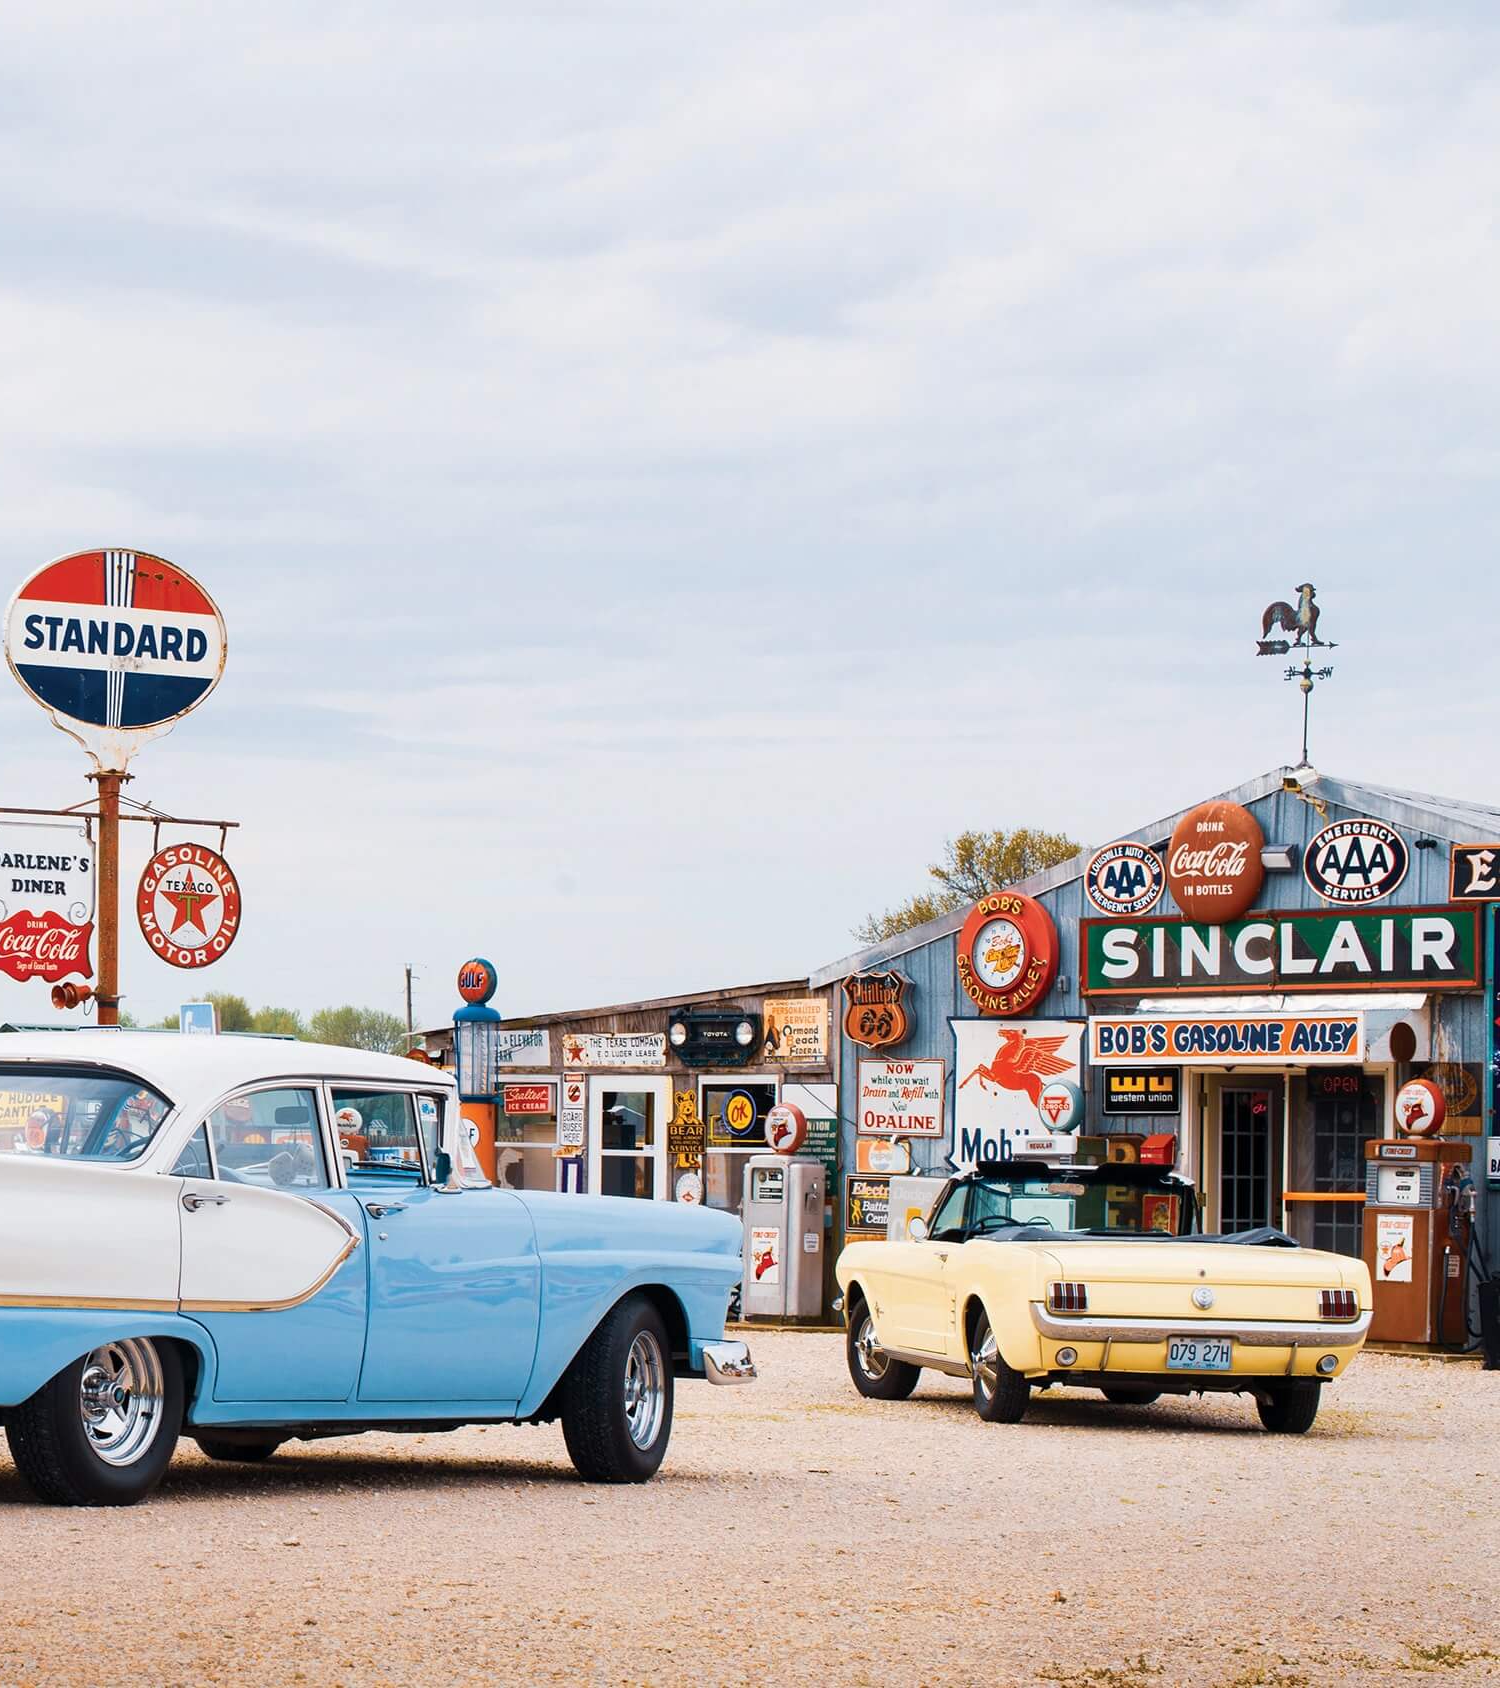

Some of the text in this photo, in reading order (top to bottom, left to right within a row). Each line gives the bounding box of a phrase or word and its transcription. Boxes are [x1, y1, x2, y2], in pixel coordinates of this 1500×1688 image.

[24, 614, 207, 663] STANDARD
[1196, 822, 1225, 833] DRINK
[1316, 823, 1395, 848] EMERGENCY
[1090, 846, 1160, 876] LOUISVILLE AUTO CLUB
[1170, 841, 1250, 878] Coca-Cola
[1320, 837, 1389, 886] AAA
[144, 848, 235, 896] GASOLINE
[1103, 861, 1147, 898] AAA
[12, 879, 67, 896] DINER
[166, 880, 213, 893] TEXACO
[1184, 884, 1233, 896] IN BOTTLES
[1324, 884, 1380, 900] SERVICE
[1090, 883, 1159, 913] EMERGENCY SERVICE
[978, 897, 1023, 915] BOB'S
[142, 912, 237, 965] MOTOR OIL
[1101, 917, 1455, 978] SINCLAIR
[16, 961, 57, 972] Sign of Good Taste
[460, 972, 484, 989] GULF
[957, 954, 1047, 1010] GASOLINE ALLEY
[772, 1006, 821, 1014] PERSONALIZED
[784, 1015, 816, 1024] SERVICE
[861, 1008, 893, 1038] 66
[783, 1025, 819, 1036] Ormond
[1099, 1022, 1357, 1054] BOB'S GASOLINE ALLEY
[509, 1034, 543, 1048] ELEVATOR
[590, 1037, 664, 1048] THE TEXAS COMPANY
[786, 1035, 819, 1046] Beach
[790, 1045, 823, 1056] FEDERAL
[886, 1064, 914, 1074] NOW
[871, 1075, 929, 1087] while you wait
[1324, 1077, 1359, 1092] OPEN
[9, 1092, 59, 1104] HUDDLE
[509, 1086, 548, 1101] Sealtest
[862, 1085, 938, 1102] Drain and Refill with
[1111, 1093, 1173, 1101] western union
[563, 1112, 582, 1121] BOARD
[732, 1106, 749, 1122] OK
[864, 1110, 936, 1129] OPALINE
[563, 1123, 582, 1131] BUSES
[670, 1127, 703, 1135] BEAR
[564, 1133, 580, 1142] HERE
[1170, 1343, 1230, 1362] 079 27H
